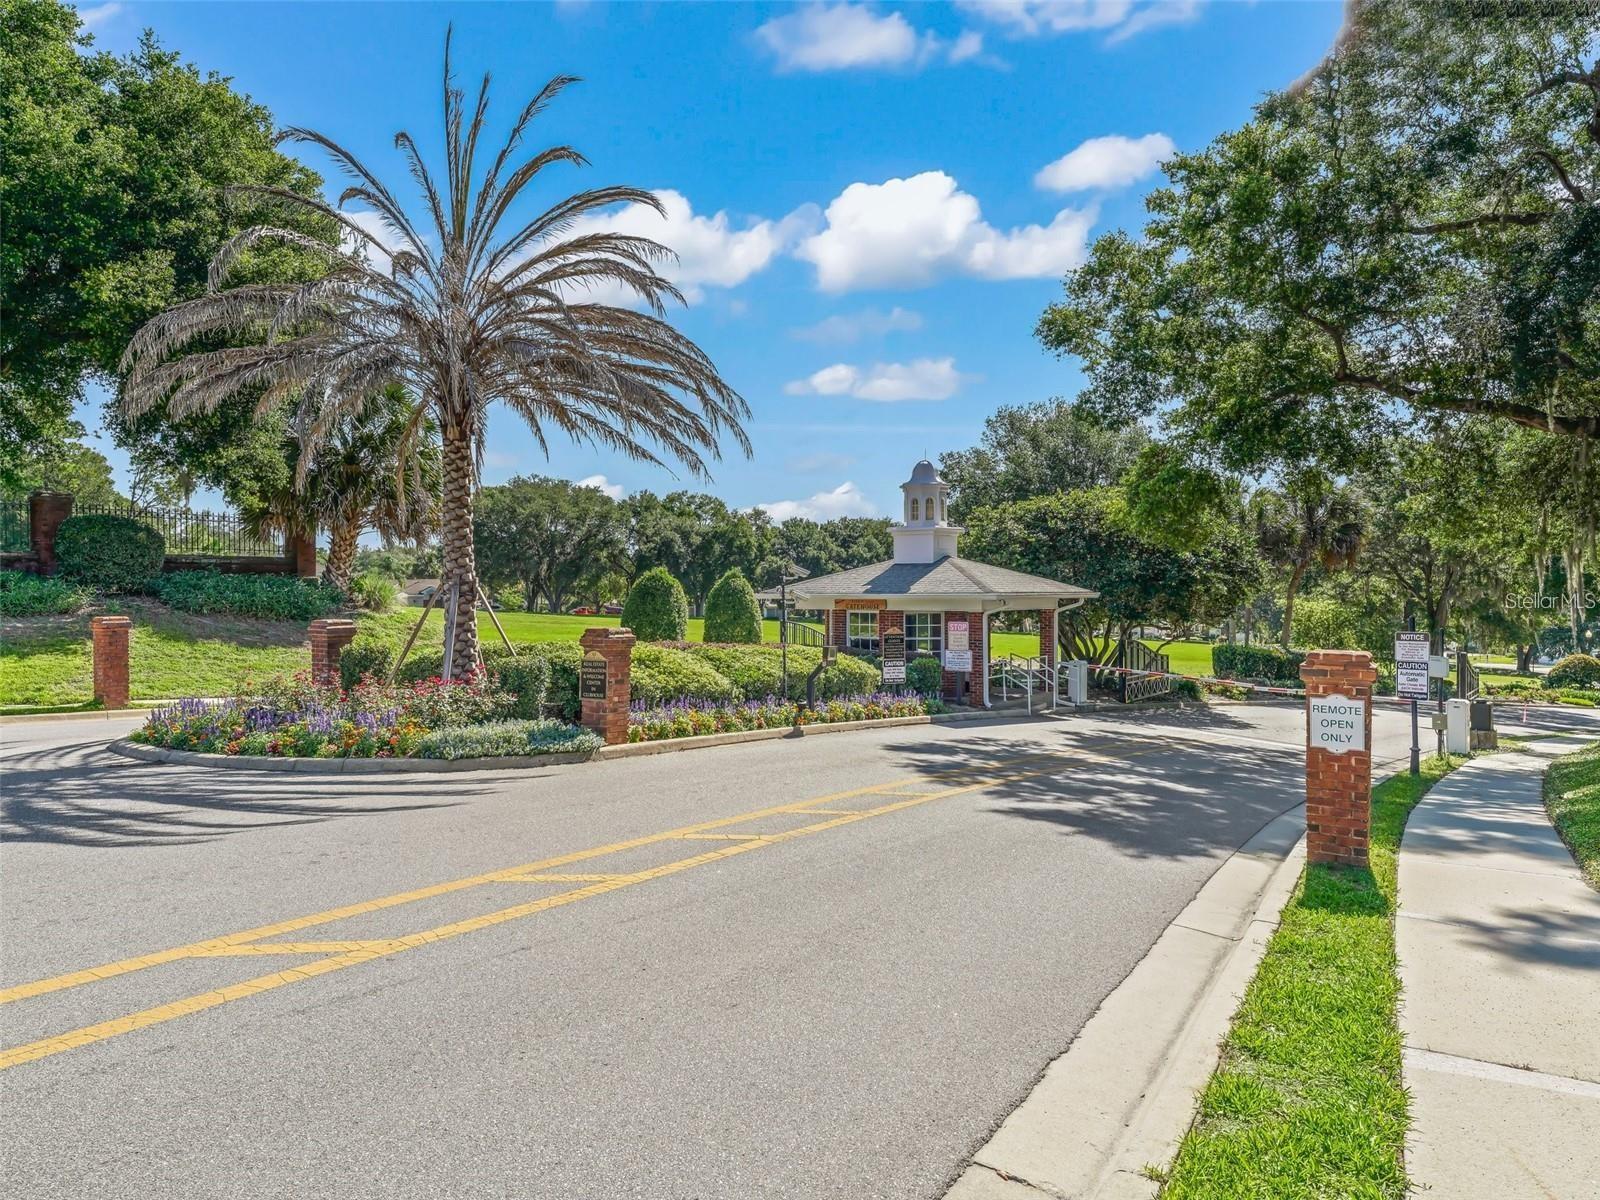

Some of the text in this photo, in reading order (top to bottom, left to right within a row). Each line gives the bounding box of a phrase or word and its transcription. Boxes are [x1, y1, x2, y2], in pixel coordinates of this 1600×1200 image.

[949, 623, 967, 631] STOP
[1398, 662, 1428, 670] CAUTION
[1312, 704, 1362, 716] REMOTE
[1320, 718, 1354, 728] OPEN
[1320, 732, 1352, 742] ONLY
